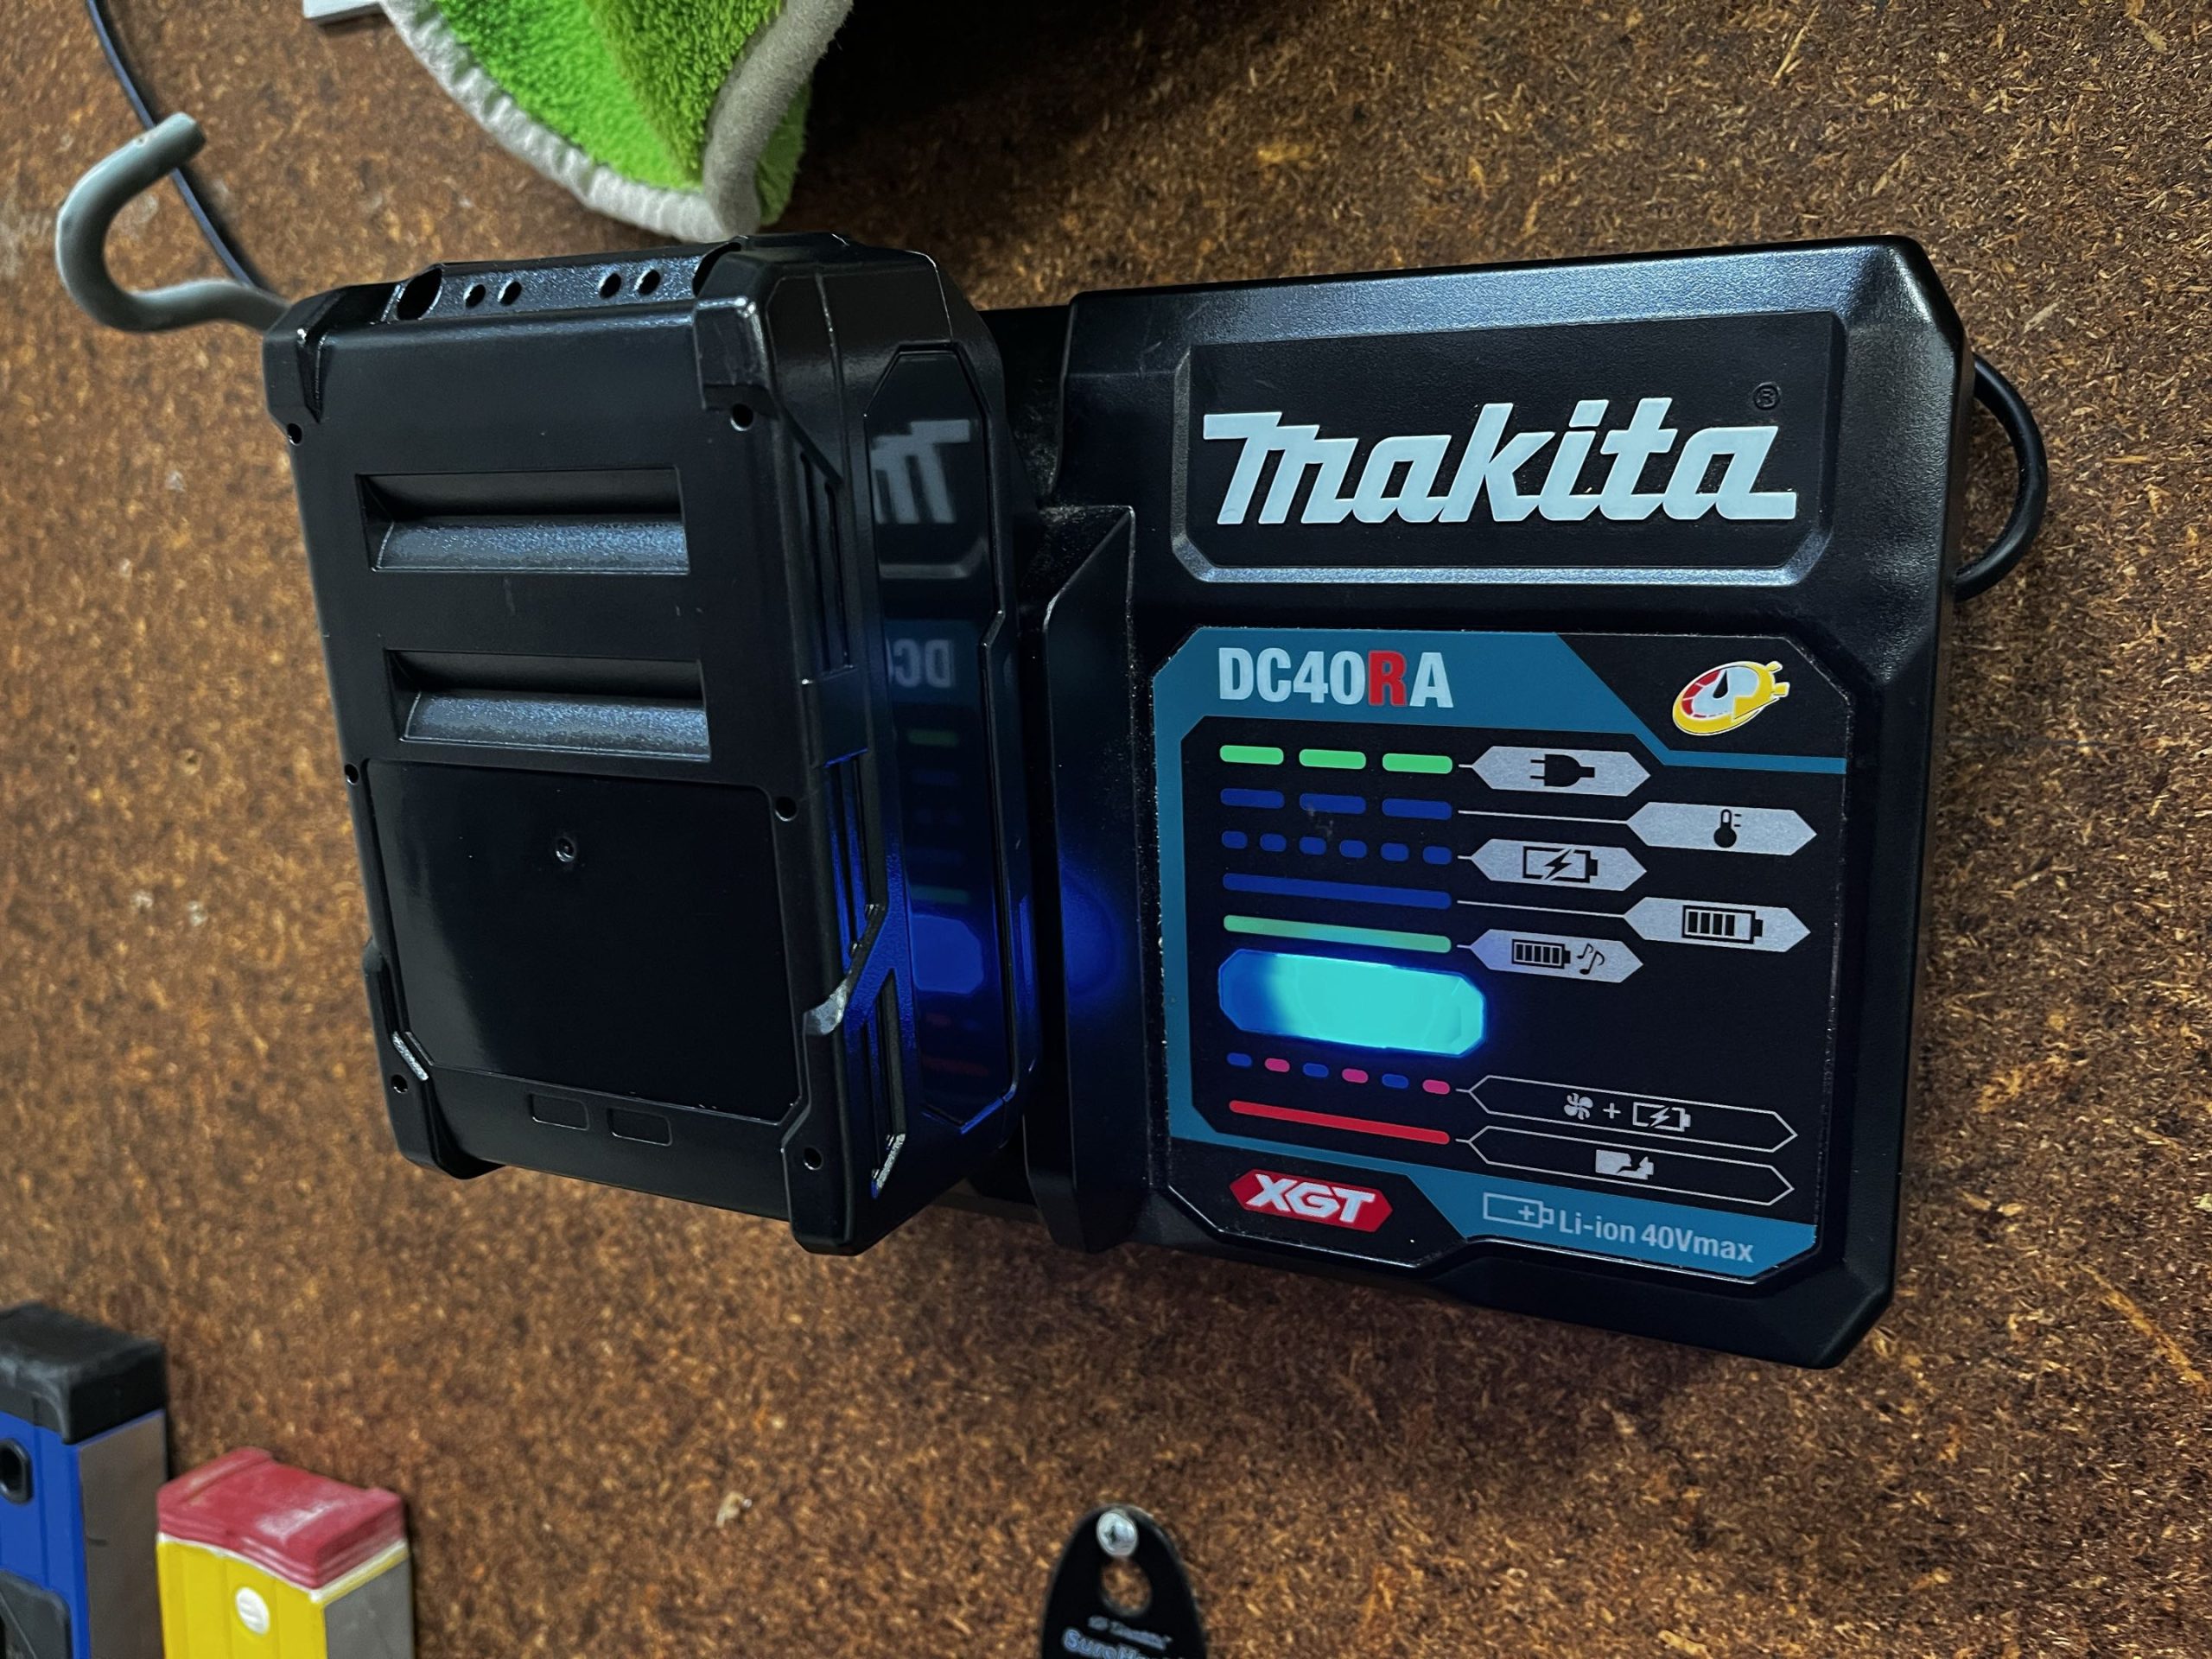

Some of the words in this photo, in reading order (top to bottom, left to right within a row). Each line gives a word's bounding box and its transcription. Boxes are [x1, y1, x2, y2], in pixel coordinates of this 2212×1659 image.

[1217, 648, 1453, 708] DC40RA
[1246, 1173, 1376, 1223] XGT
[1559, 1209, 1636, 1244] Li-ion
[1641, 1224, 1754, 1264] 40Vmax
